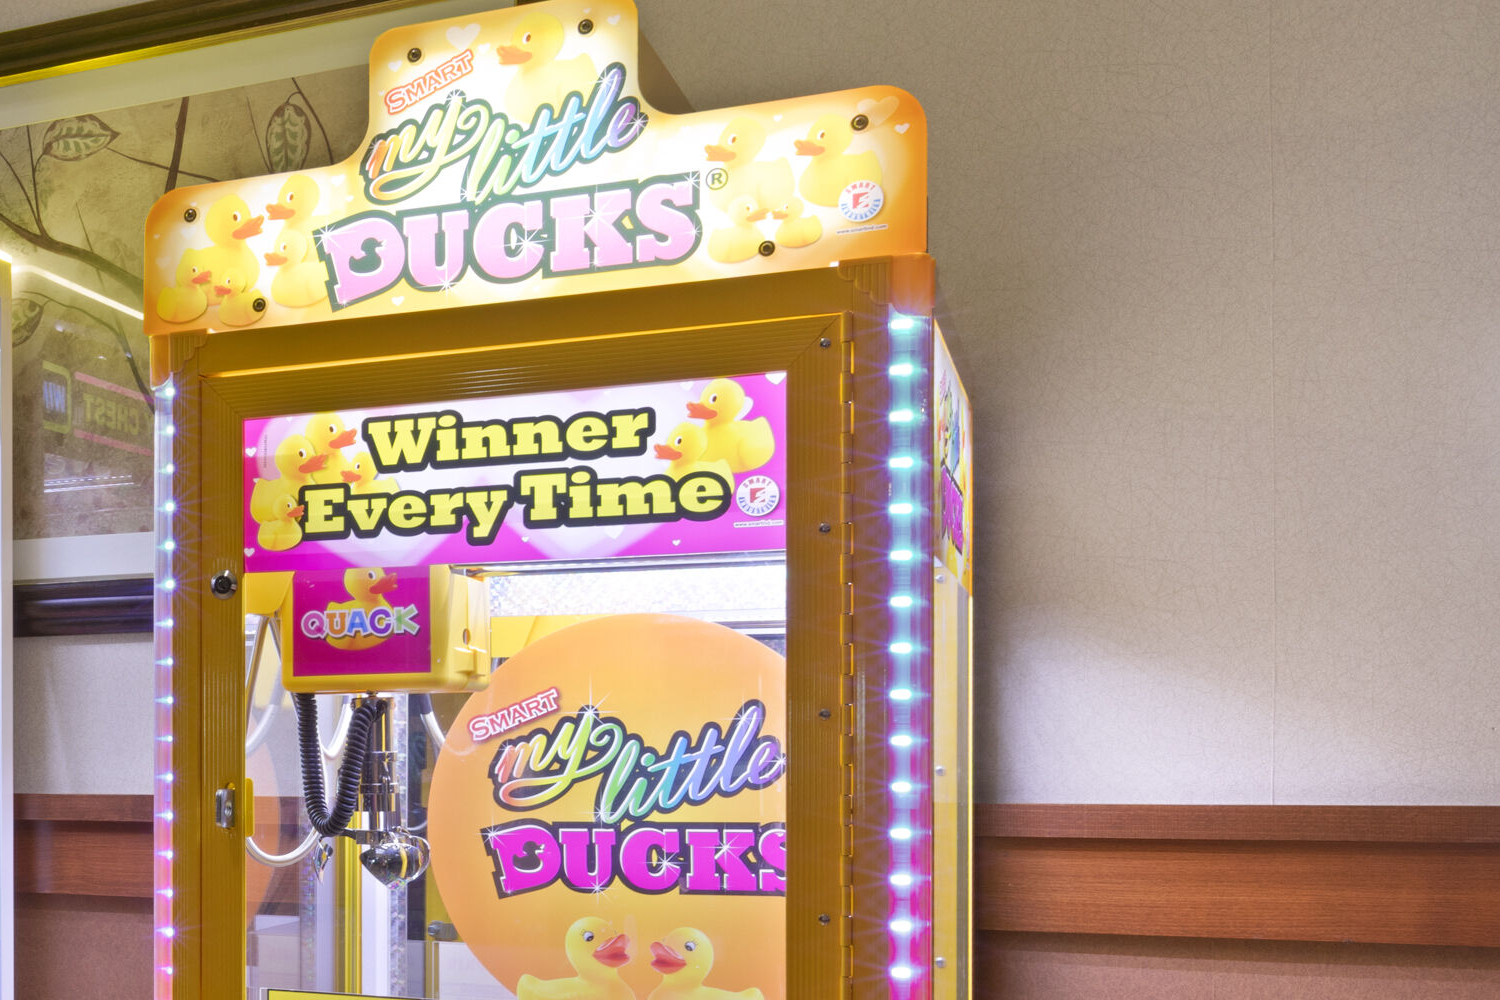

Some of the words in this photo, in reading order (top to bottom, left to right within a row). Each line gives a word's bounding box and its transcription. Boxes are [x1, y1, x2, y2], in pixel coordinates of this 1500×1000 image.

[385, 49, 473, 115] SMART
[361, 89, 490, 203] my
[464, 63, 649, 205] little
[318, 176, 700, 309] DUCKS
[366, 406, 653, 470] Winner
[302, 482, 510, 543] Every
[516, 469, 730, 525] Time
[301, 604, 420, 639] QUACK
[468, 686, 561, 742] SMART
[492, 709, 623, 808] my
[596, 704, 784, 825] little
